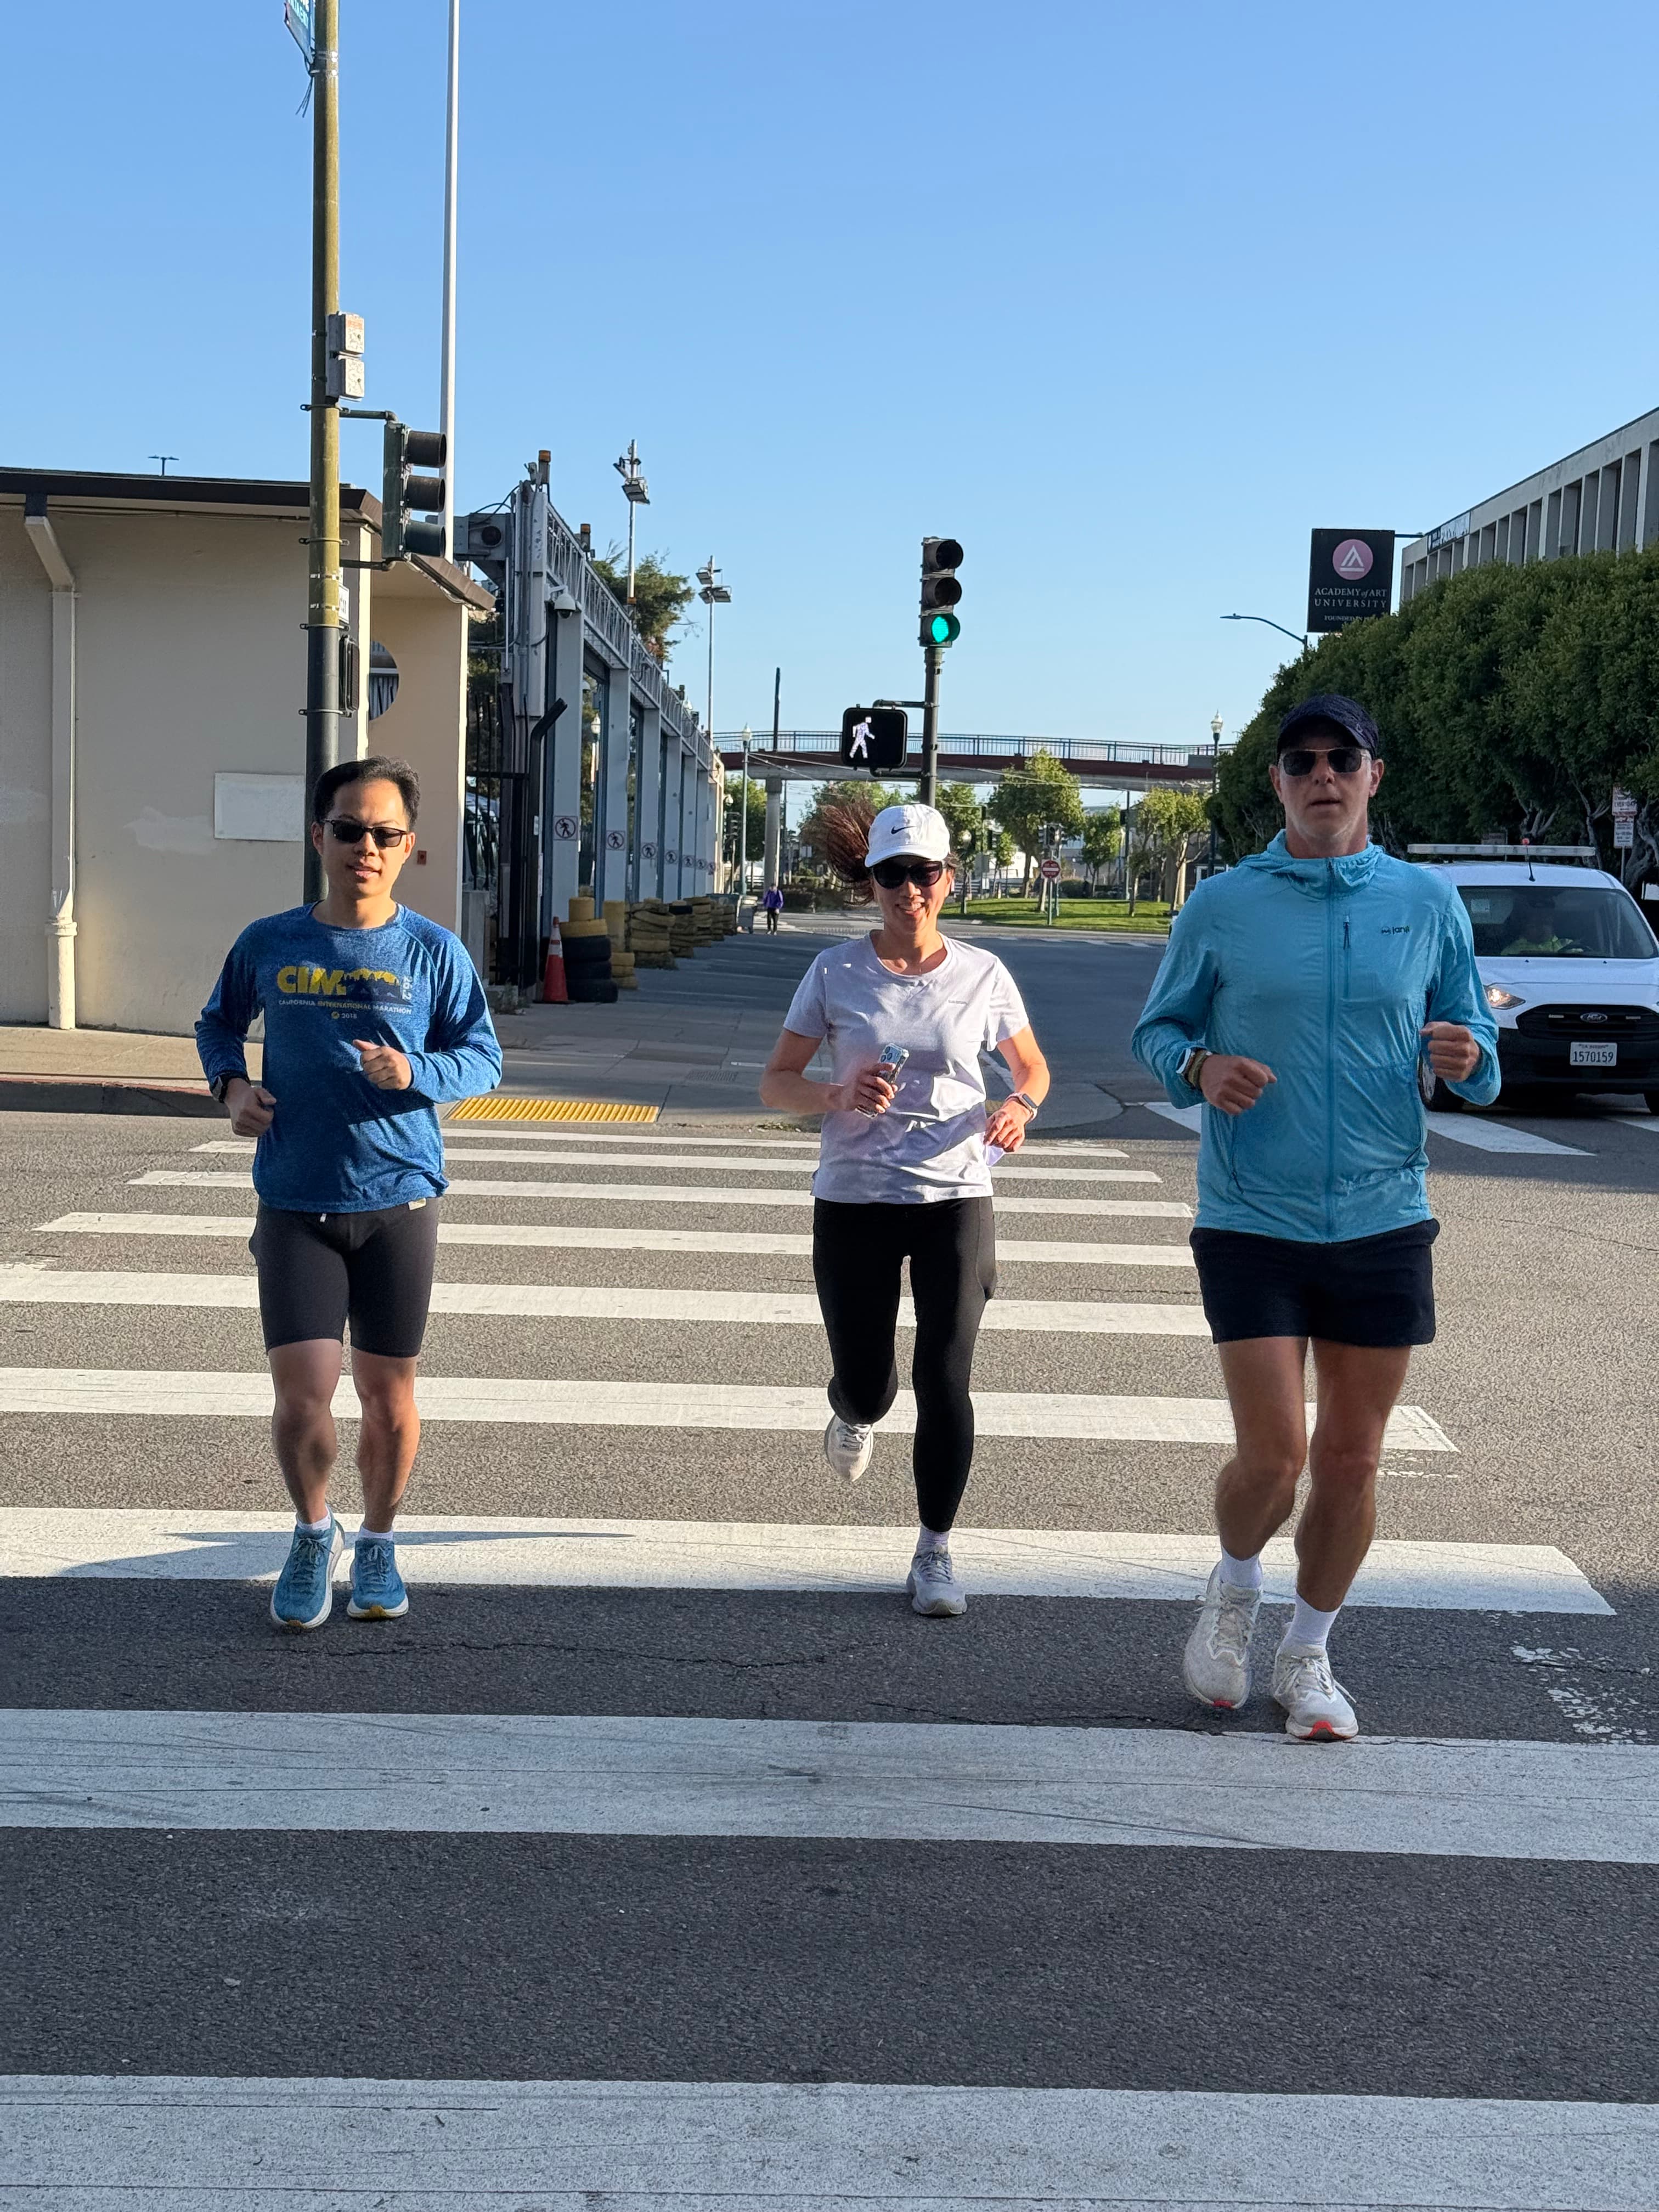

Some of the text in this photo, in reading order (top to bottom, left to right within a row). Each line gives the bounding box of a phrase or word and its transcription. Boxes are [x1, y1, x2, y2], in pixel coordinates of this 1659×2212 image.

[1314, 588, 1387, 599] ACADEMY of ART
[1314, 598, 1387, 608] UNIVERSITY
[402, 975, 413, 1001] 26.2
[318, 1001, 371, 1009] INTERNATIONAL
[373, 1005, 412, 1014] MARATHON
[1573, 1051, 1614, 1063] 1570159
